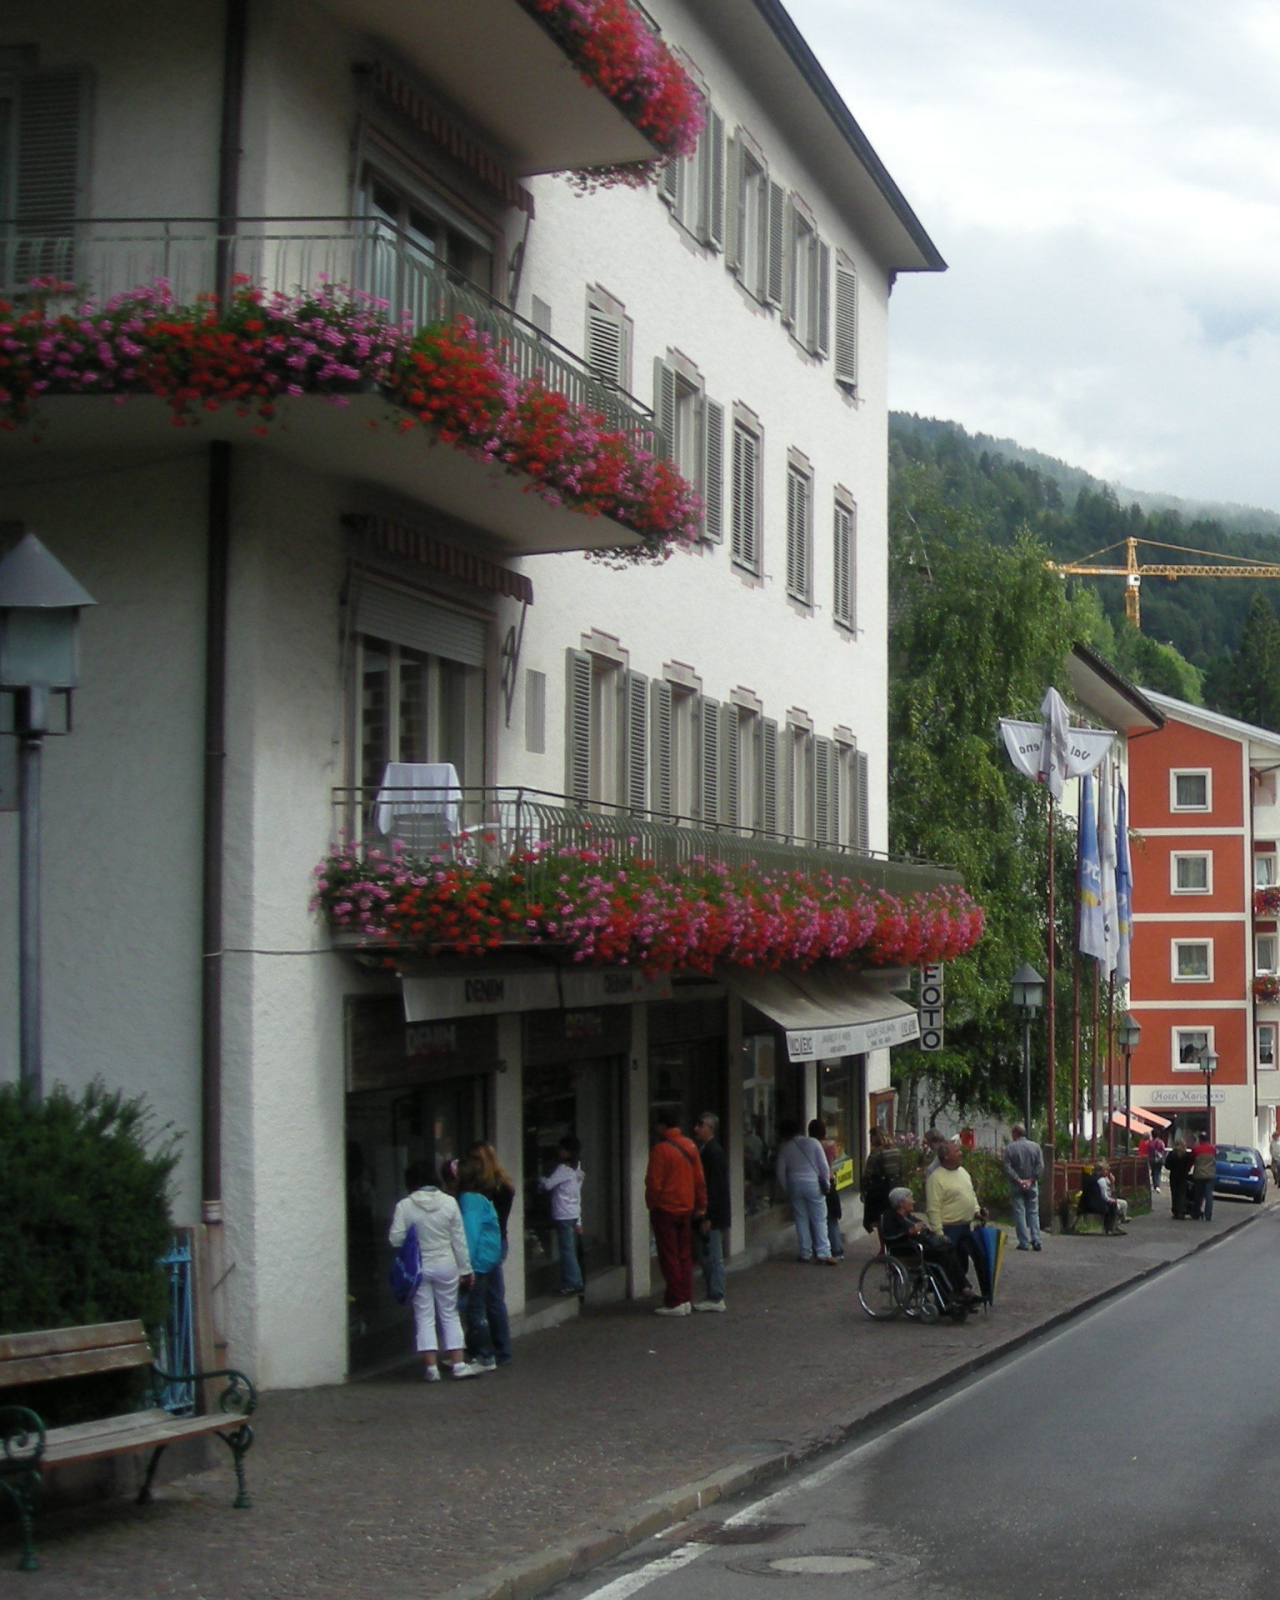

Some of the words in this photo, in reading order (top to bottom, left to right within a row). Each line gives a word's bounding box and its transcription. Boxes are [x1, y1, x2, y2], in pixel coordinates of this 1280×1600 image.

[465, 978, 504, 1003] DENIM
[922, 965, 941, 1049] FOTO
[1154, 1091, 1179, 1101] Hotel
